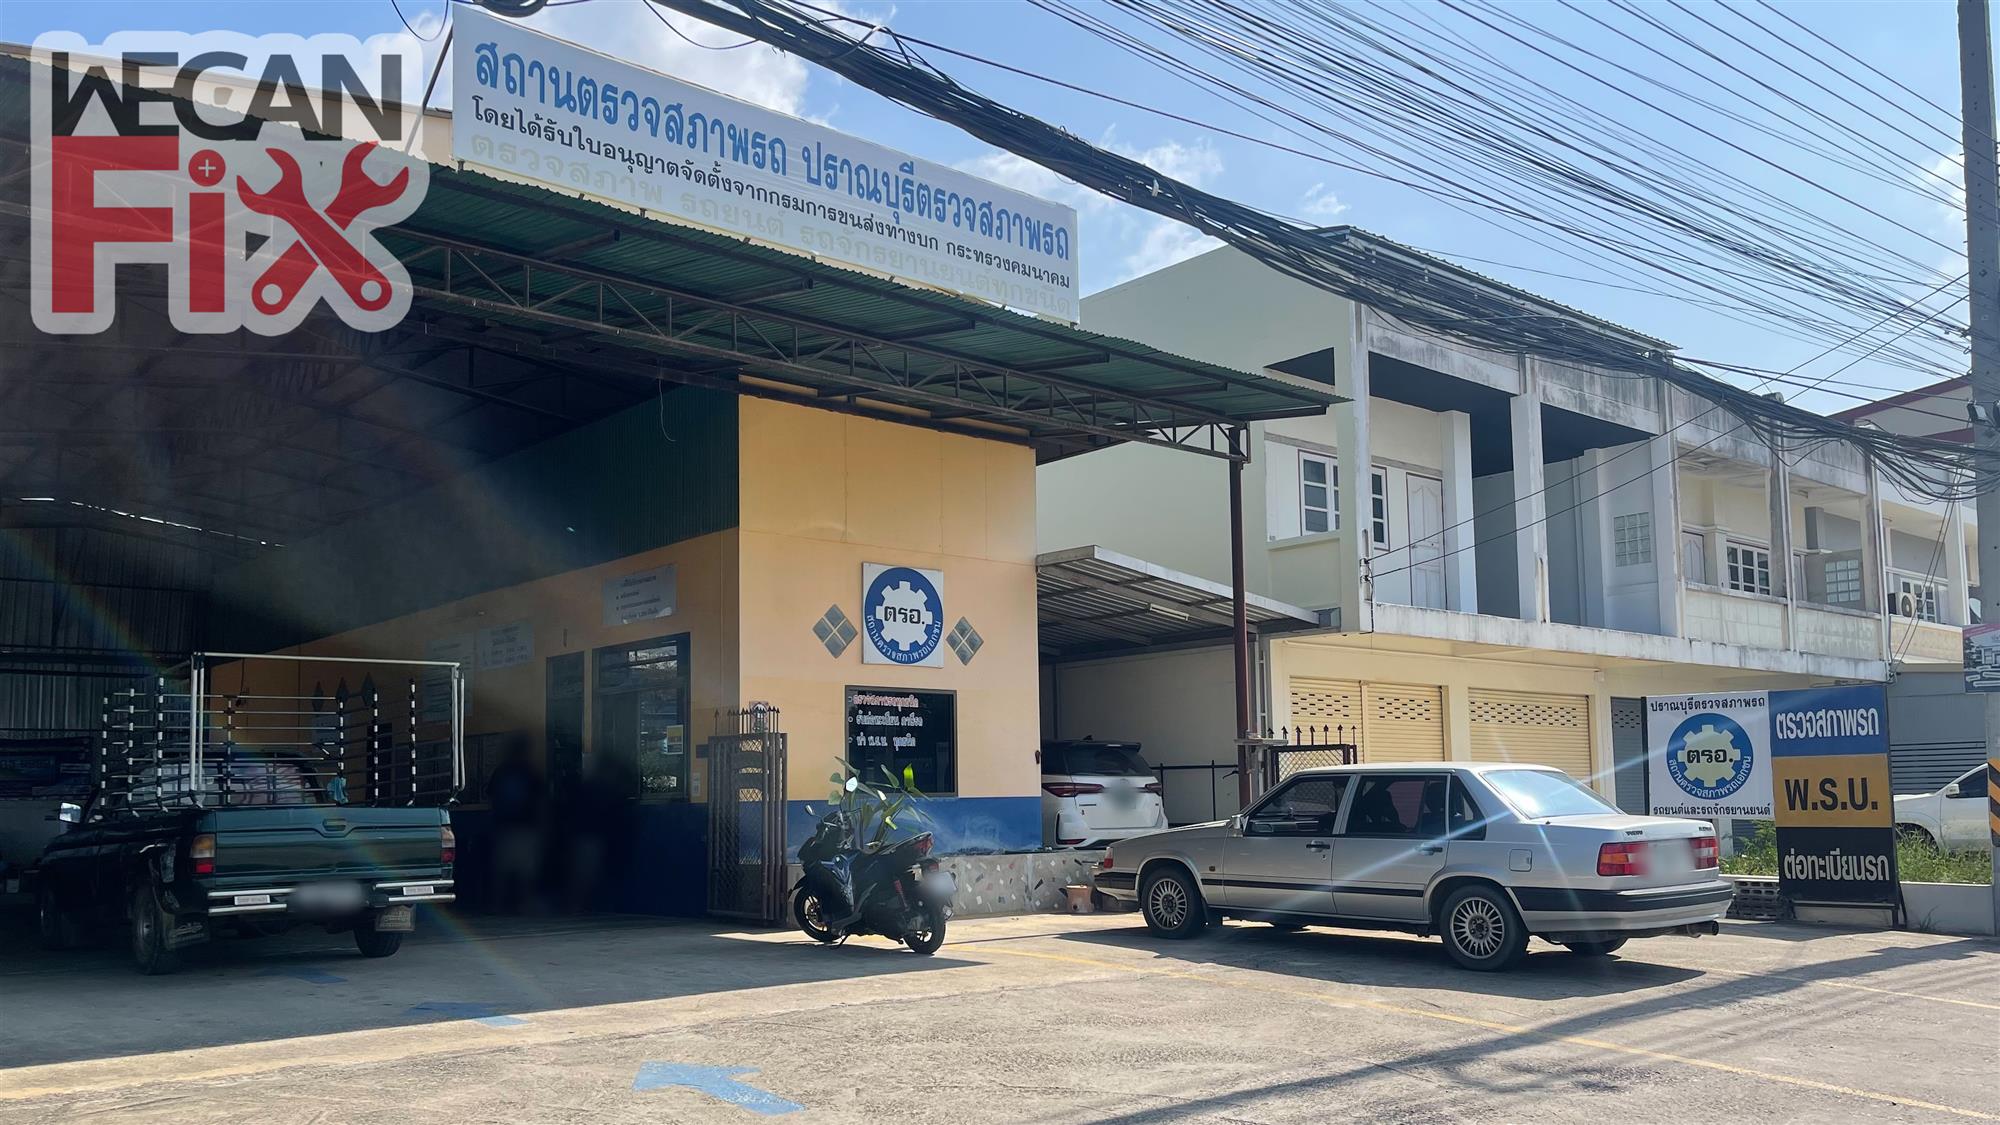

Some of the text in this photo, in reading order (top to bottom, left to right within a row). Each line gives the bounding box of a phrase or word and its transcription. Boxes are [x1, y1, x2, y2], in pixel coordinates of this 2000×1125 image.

[475, 41, 1069, 261] สถานตรวจสภาพรถ ปราณบุรีตรวจสภาพรถ
[471, 133, 664, 205] ตรวจสภาพ
[472, 95, 1070, 289] โดยได้รับใบอนุญาตจัดตั้งจากกรมการขนส่งทางบก กระทรวงคมนาคม
[884, 605, 925, 625] ตรอ.
[1650, 696, 1765, 715] ปราณบุรีตรวจสภาพรถ
[1776, 707, 1880, 740] ตรวจสภาพรถ
[1686, 748, 1734, 764] ตรอ.
[1668, 755, 1752, 798] สถานตรวจสภาพรถเอกชน
[1653, 803, 1771, 815] รถยนต์และรถจักรยานยนต์
[1784, 847, 1890, 881] ต่อทะเบียนรถ
